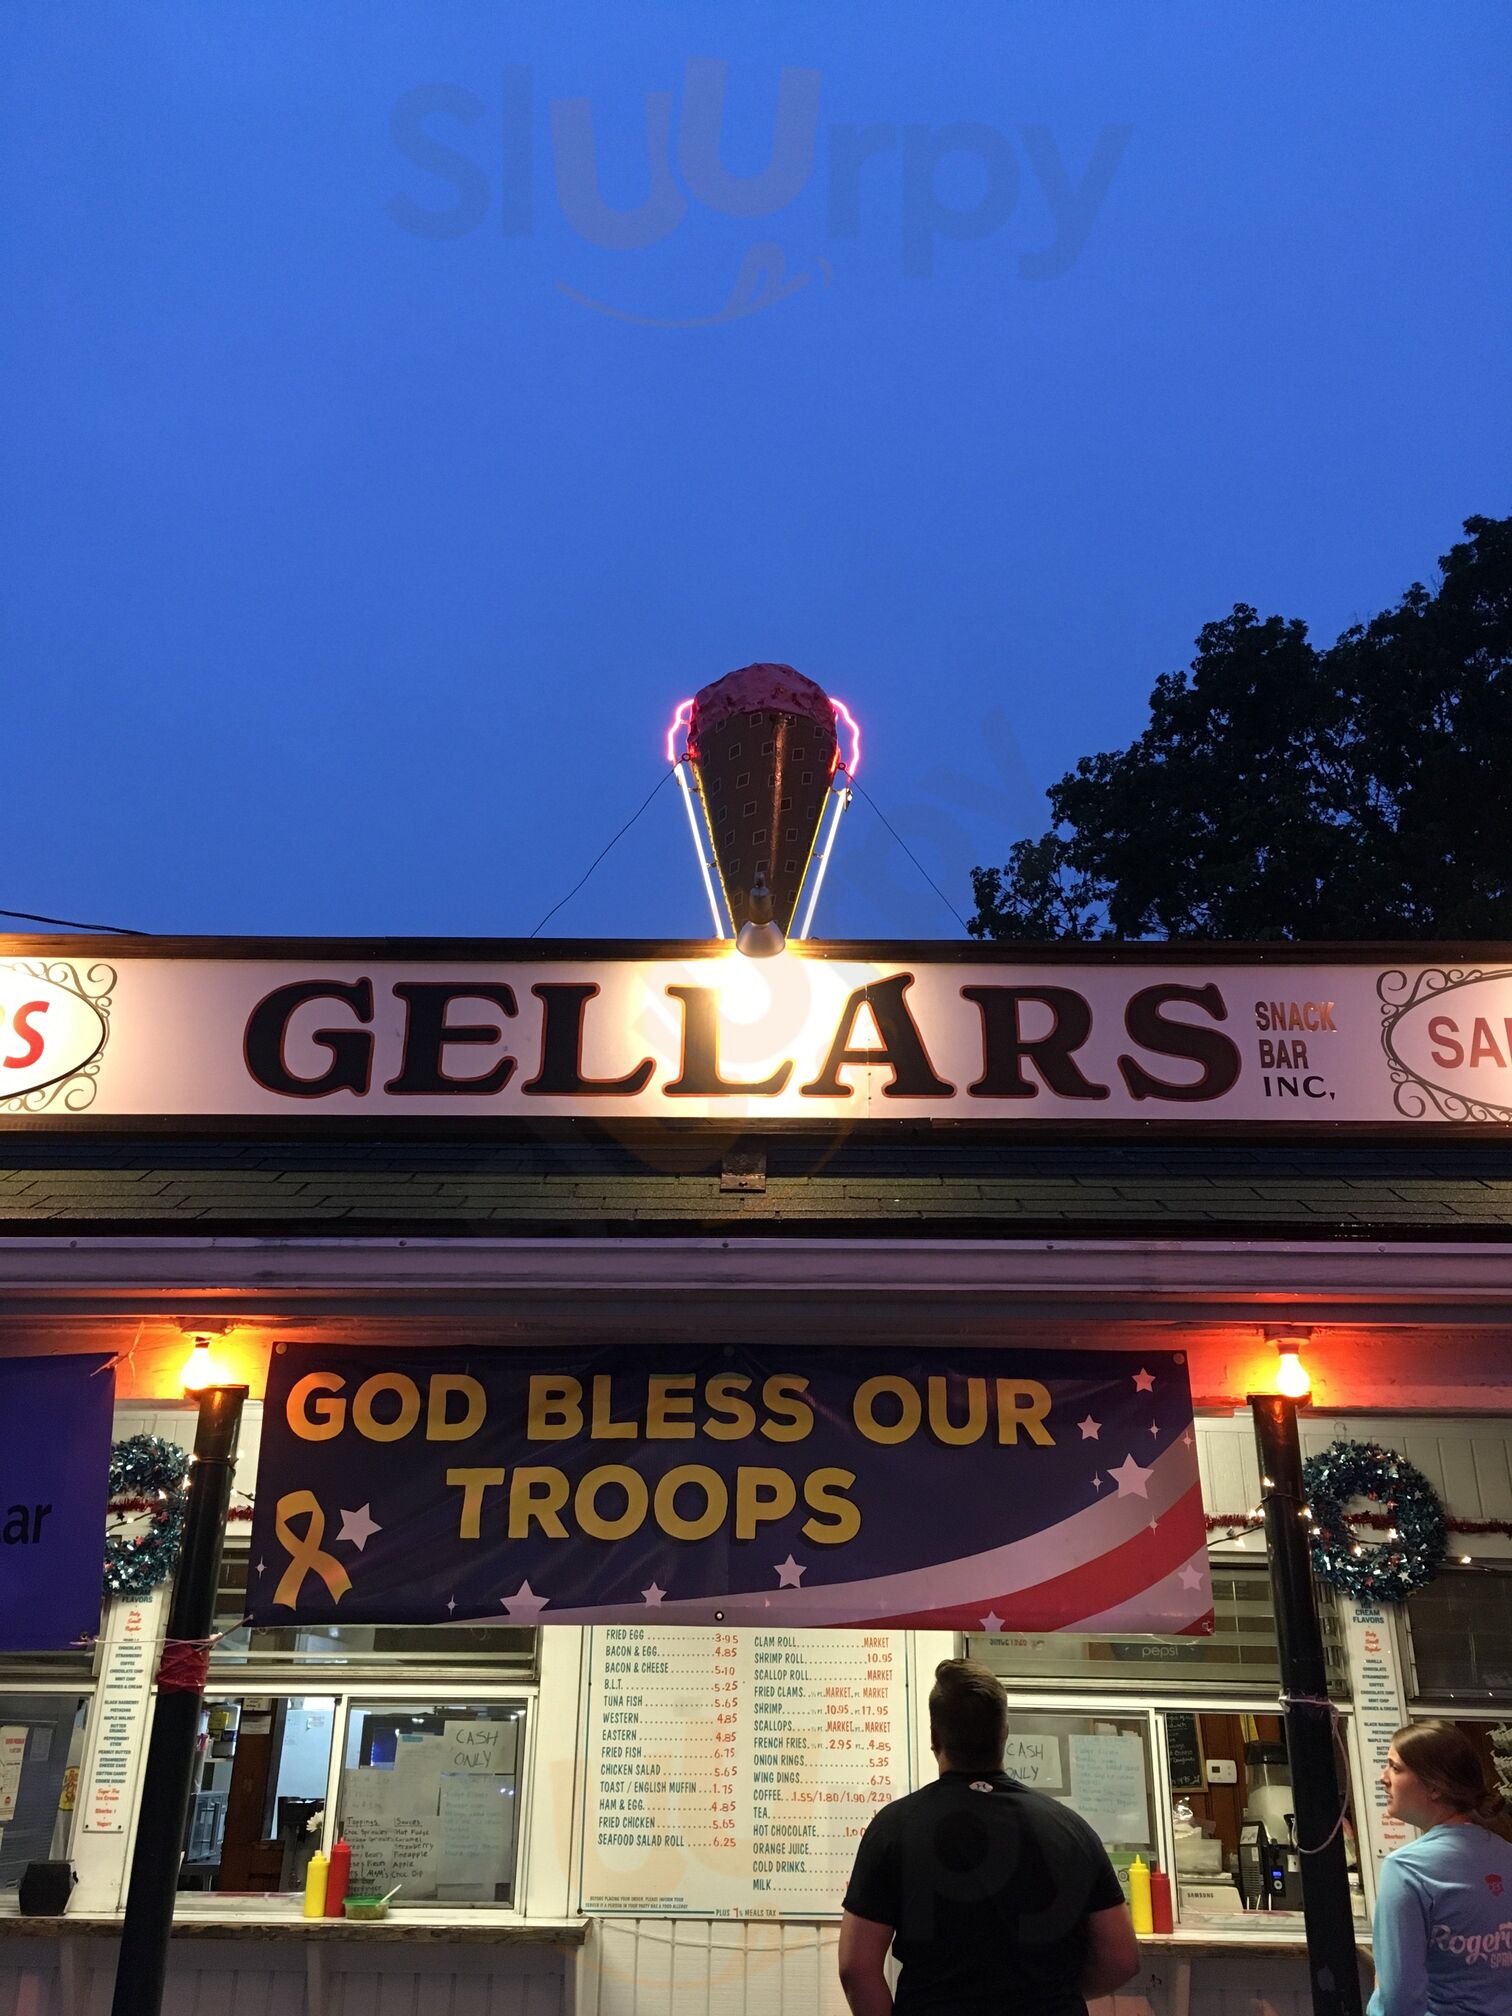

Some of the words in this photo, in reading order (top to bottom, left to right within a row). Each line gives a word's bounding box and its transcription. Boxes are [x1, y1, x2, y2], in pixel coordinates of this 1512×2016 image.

[1255, 1001, 1338, 1033] SNACK
[242, 971, 1242, 1102] GELLARS
[1259, 1039, 1309, 1069] BAR
[286, 1371, 488, 1442] GOD
[527, 1373, 815, 1443] BLESS
[853, 1375, 1057, 1446] OUR
[446, 1464, 862, 1545] TROOPS
[607, 1630, 626, 1640] FRIED
[630, 1630, 644, 1640] EGG
[754, 1636, 775, 1647] CLAM
[778, 1637, 796, 1647] ROLL
[864, 1637, 888, 1648] MARKET
[606, 1646, 631, 1657] BACON
[635, 1647, 639, 1656] &
[643, 1646, 657, 1657] EGG
[715, 1647, 737, 1657] 4.85
[1142, 1646, 1179, 1657] pepsi
[754, 1653, 782, 1664] SHRIMP
[785, 1654, 804, 1664] ROLL
[868, 1653, 892, 1663] 10.95
[605, 1663, 631, 1673] BACON
[634, 1664, 639, 1673] &
[642, 1663, 668, 1673] CHEESE
[715, 1666, 735, 1676] 5.10
[754, 1670, 787, 1681] SCALLOP
[790, 1670, 809, 1681] ROLL
[868, 1670, 892, 1681] MARKET
[714, 1681, 738, 1692] 5.25
[754, 1687, 775, 1698] FRIED
[778, 1687, 803, 1698] CLAMS
[826, 1687, 851, 1698] MARKET
[863, 1688, 888, 1698] MARKET
[604, 1696, 623, 1706] TUNA
[626, 1696, 642, 1706] FISH
[715, 1698, 738, 1708] 5.65
[754, 1704, 783, 1714] SHRIMP
[603, 1713, 638, 1724] WESTERN
[717, 1714, 737, 1724] 4.85
[754, 1721, 792, 1731] SCALLOPS
[827, 1722, 853, 1732] MARKET
[865, 1722, 890, 1733] MARKET
[456, 1729, 499, 1746] CASH
[602, 1730, 636, 1741] EASTERN
[716, 1732, 736, 1742] 4.85
[754, 1737, 783, 1748] FRENCH
[786, 1738, 806, 1749] FRIES
[829, 1740, 851, 1750] 2.95
[869, 1740, 891, 1751] 4.85
[602, 1747, 622, 1758] FRIED
[625, 1747, 642, 1757] FISH
[714, 1748, 735, 1759] 6.75
[1006, 1742, 1043, 1760] CASH
[454, 1750, 492, 1768] ONLY
[754, 1755, 778, 1766] ONION
[781, 1755, 804, 1766] RINGS
[869, 1757, 888, 1767] 5.35
[601, 1764, 633, 1775] CHICKEN
[636, 1765, 660, 1775] SALAD
[714, 1766, 737, 1777] 5.65
[754, 1772, 773, 1783] WING
[777, 1773, 800, 1783] DINGS
[871, 1776, 891, 1785] 6.75
[600, 1782, 624, 1793] TOAST
[635, 1782, 666, 1793] ENGLISH
[669, 1782, 696, 1793] MUFFIN
[754, 1789, 781, 1801] COFFEE
[600, 1799, 616, 1810] HAM
[620, 1800, 624, 1810] &
[711, 1801, 736, 1812] 4.85
[754, 1807, 768, 1819] TEA
[599, 1817, 620, 1828] FRIED
[623, 1817, 655, 1828] CHICKEN
[713, 1820, 735, 1829] 5.65
[754, 1825, 768, 1836] HOT
[771, 1825, 816, 1837] CHOCOLATE
[598, 1834, 634, 1846] SEAFOOD
[636, 1835, 661, 1846] SALAD
[665, 1836, 684, 1847] ROLL
[713, 1837, 736, 1847] 6.25
[753, 1843, 785, 1854] ORANGE
[788, 1843, 809, 1854] JUICE
[753, 1861, 773, 1872] COLD
[776, 1861, 805, 1872] DRINKS
[753, 1879, 771, 1890] MILK
[745, 1909, 764, 1917] MEALS
